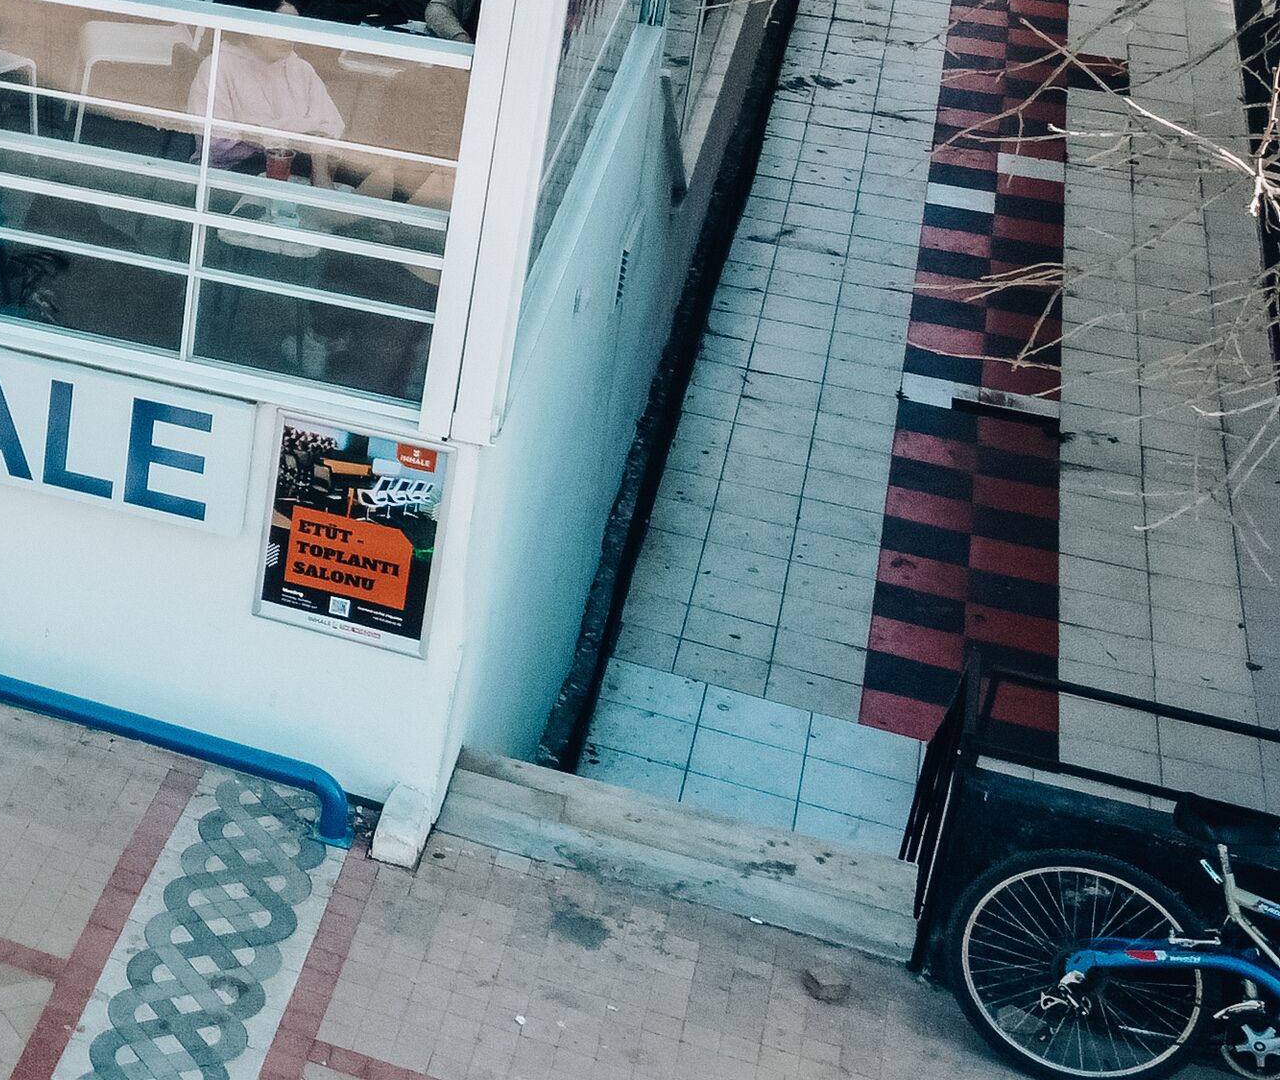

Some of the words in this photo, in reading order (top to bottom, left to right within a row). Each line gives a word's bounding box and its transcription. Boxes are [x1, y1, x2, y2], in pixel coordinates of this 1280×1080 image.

[297, 519, 353, 544] ETÜT
[296, 540, 401, 577] TOPLANTI
[292, 561, 376, 592] SALONU
